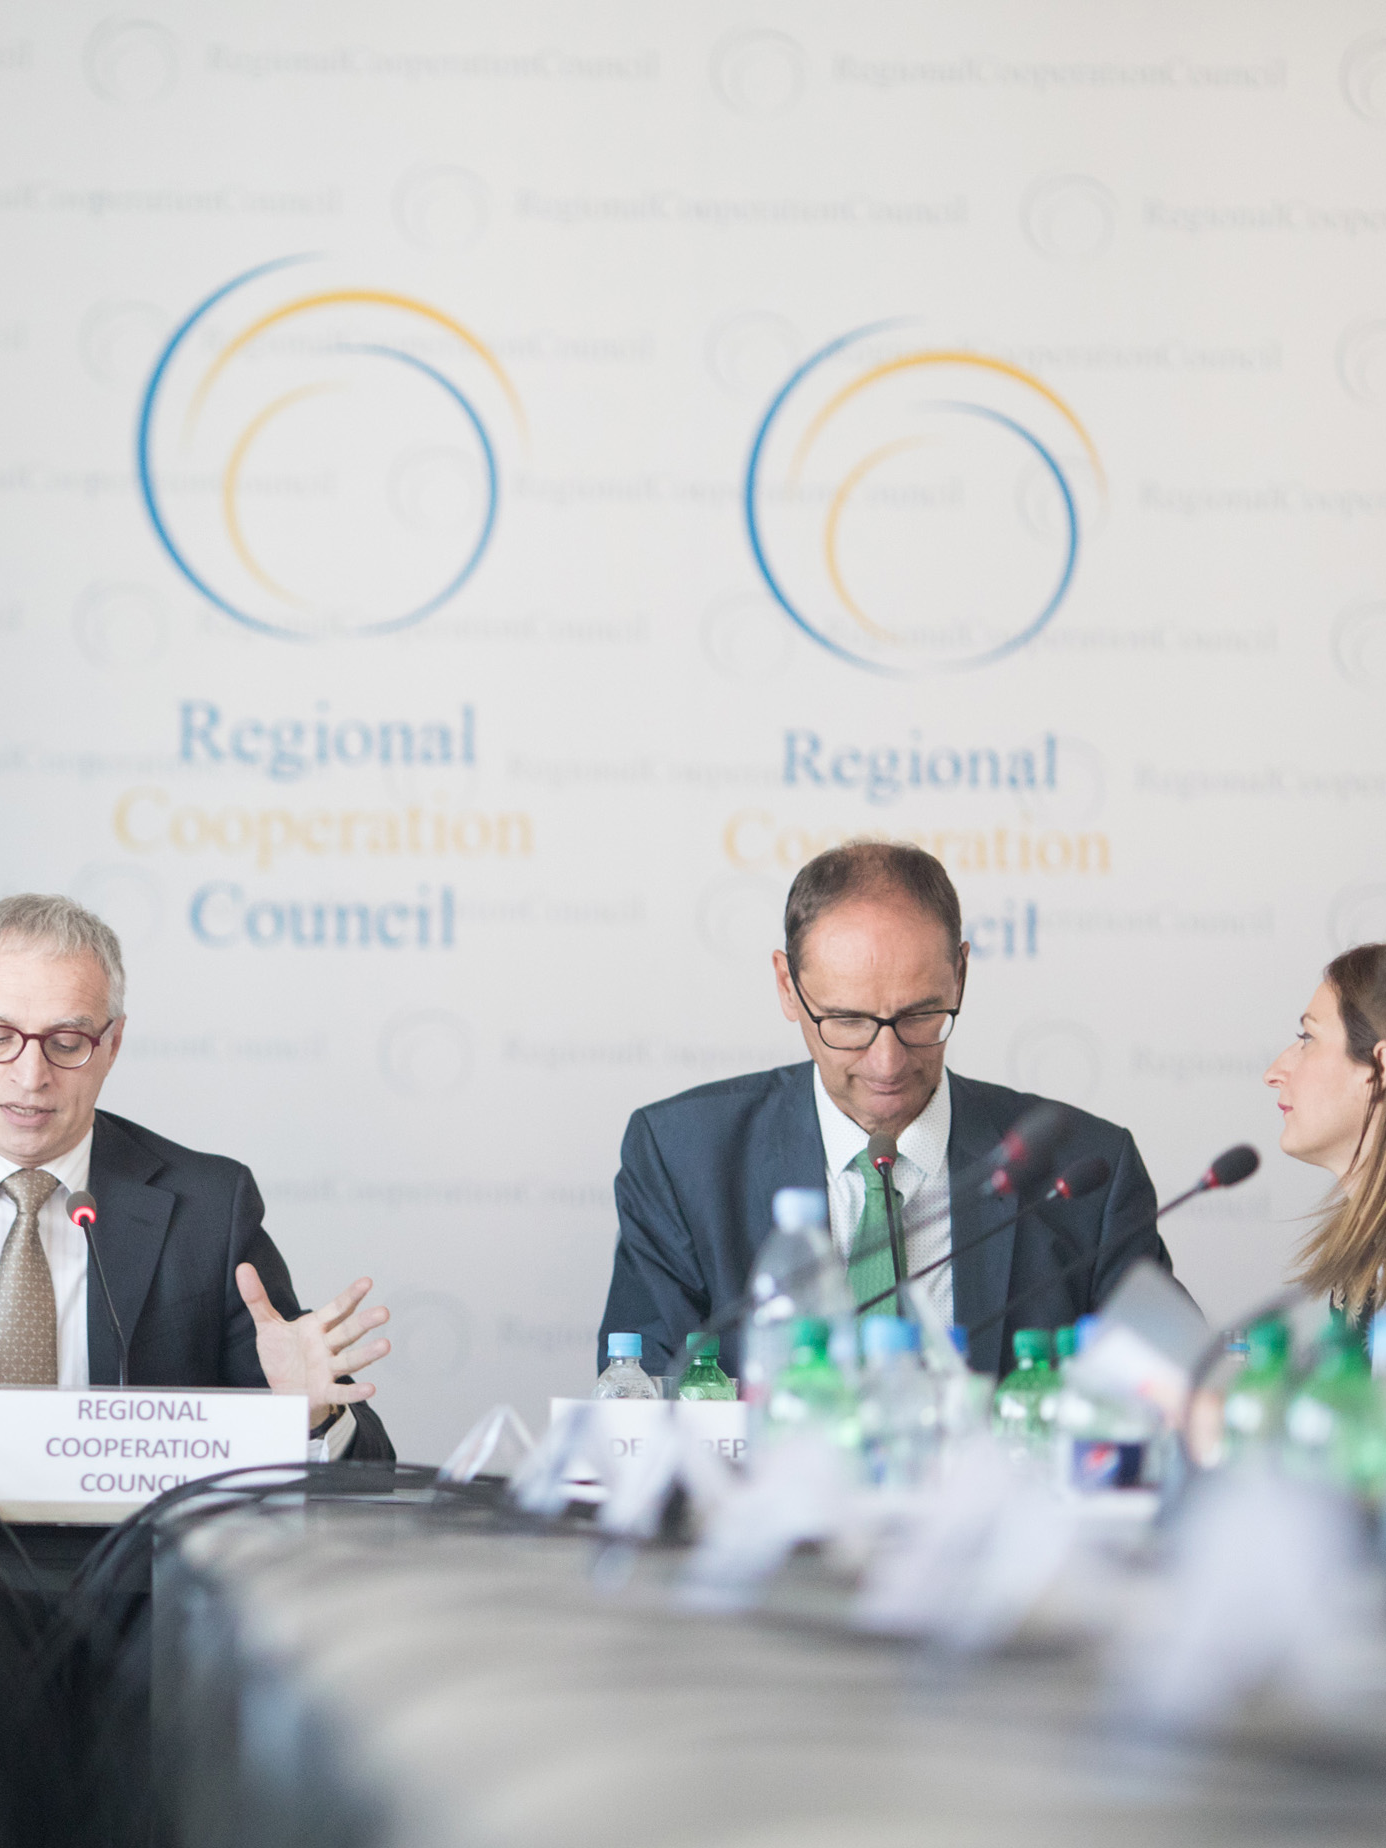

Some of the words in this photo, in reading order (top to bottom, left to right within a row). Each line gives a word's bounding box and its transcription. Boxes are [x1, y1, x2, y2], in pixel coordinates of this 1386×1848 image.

[178, 700, 476, 782] Regional
[782, 730, 1057, 804] Regional
[112, 789, 536, 871] Cooperation
[722, 808, 1112, 875] Coration
[187, 882, 455, 949] Council
[78, 1399, 208, 1422] REGIONAL
[46, 1437, 230, 1459] COOPERATION
